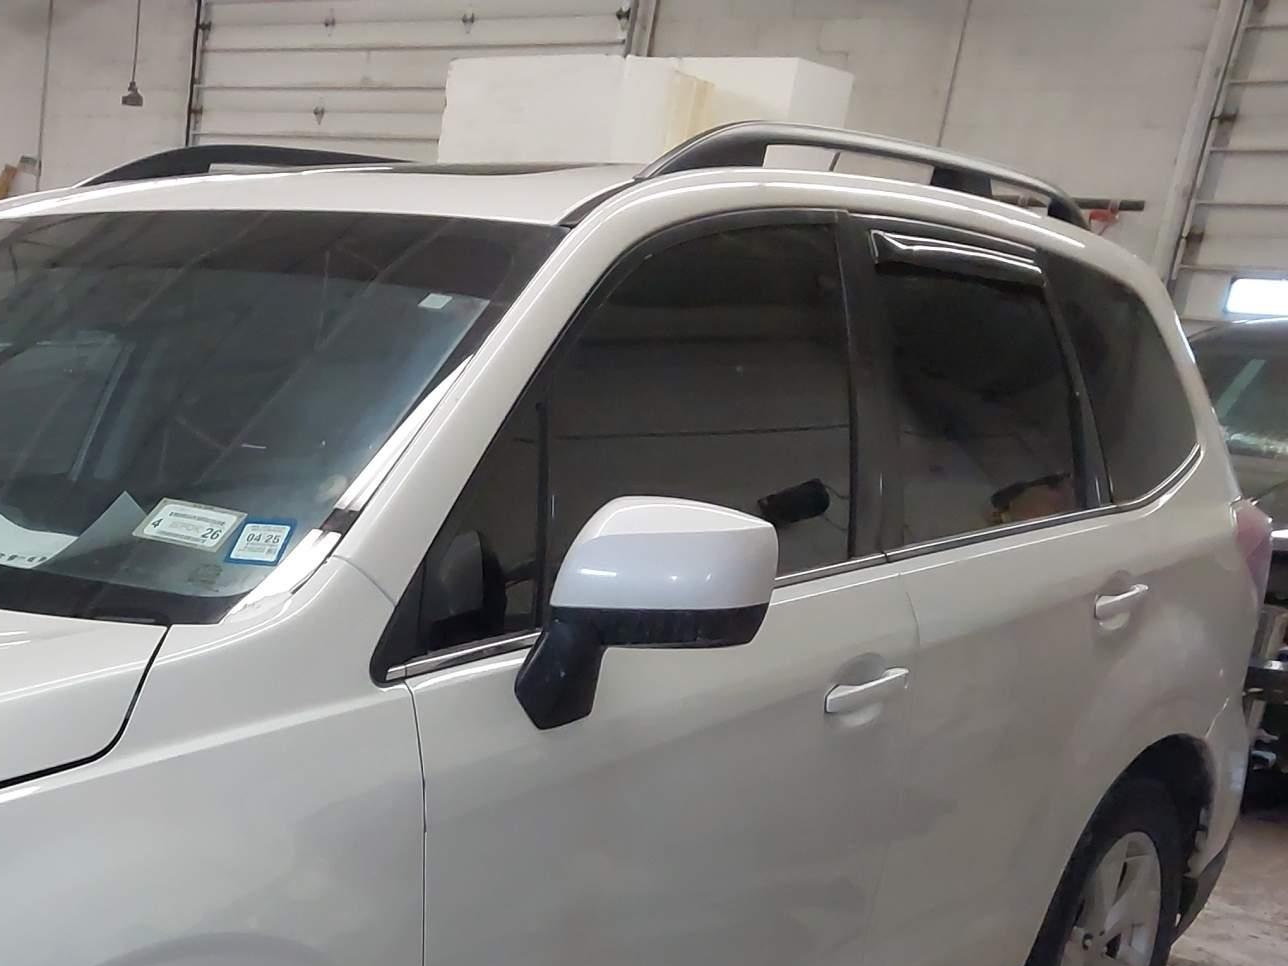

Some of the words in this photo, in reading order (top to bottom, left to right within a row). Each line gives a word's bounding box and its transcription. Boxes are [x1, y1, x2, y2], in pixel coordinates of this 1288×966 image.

[152, 518, 164, 528] 4
[201, 527, 222, 540] 26
[246, 533, 262, 543] 04
[264, 534, 282, 544] 25
